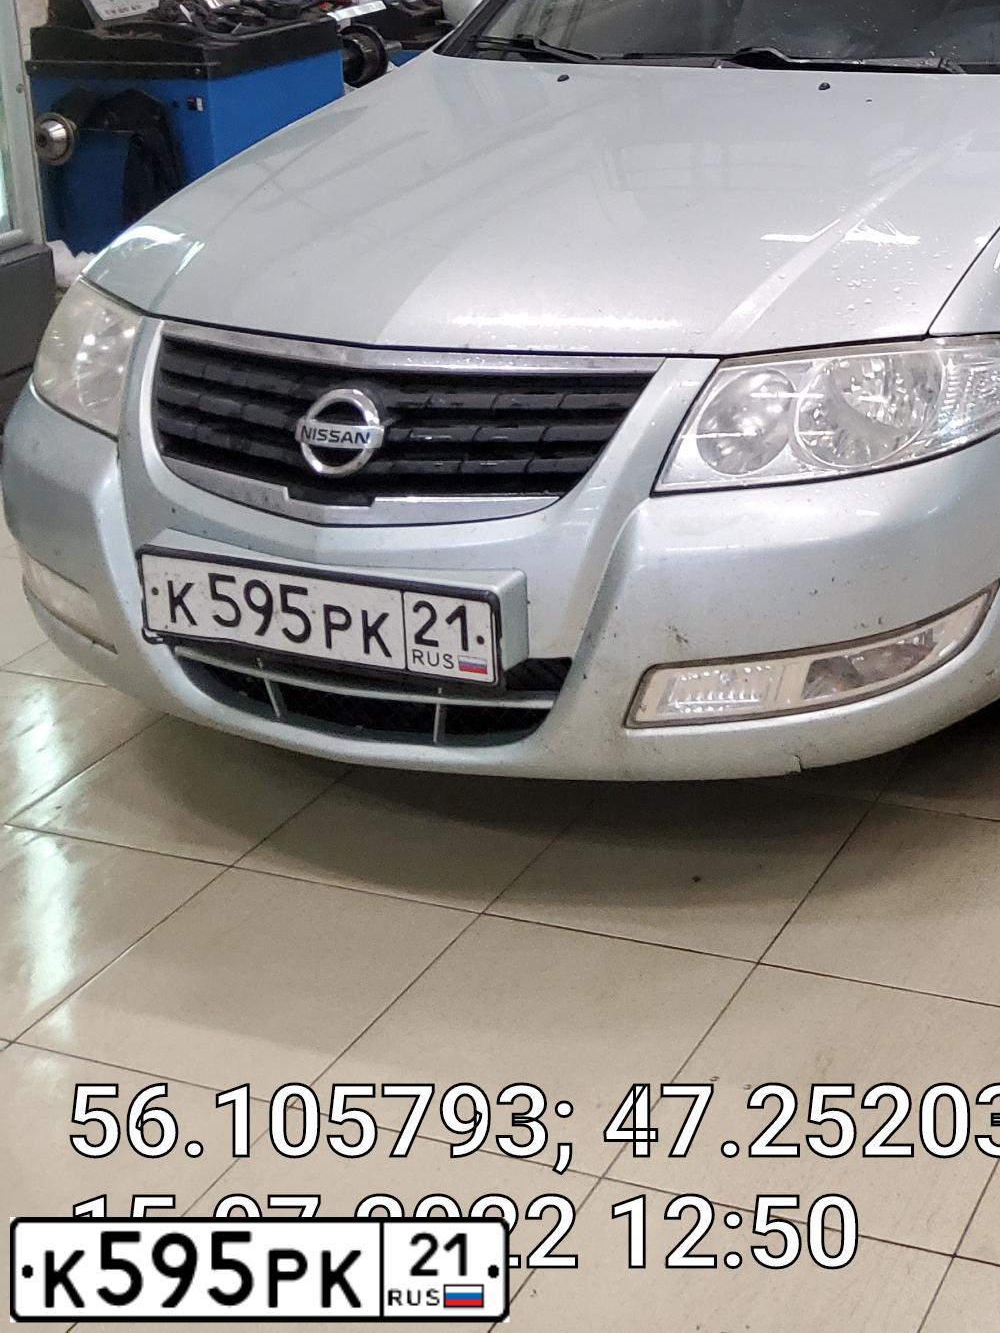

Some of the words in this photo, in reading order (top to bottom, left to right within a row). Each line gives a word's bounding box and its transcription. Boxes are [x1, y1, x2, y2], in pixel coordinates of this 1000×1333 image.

[301, 426, 370, 444] NISSAN
[412, 600, 470, 651] 21
[412, 649, 455, 670] RUS
